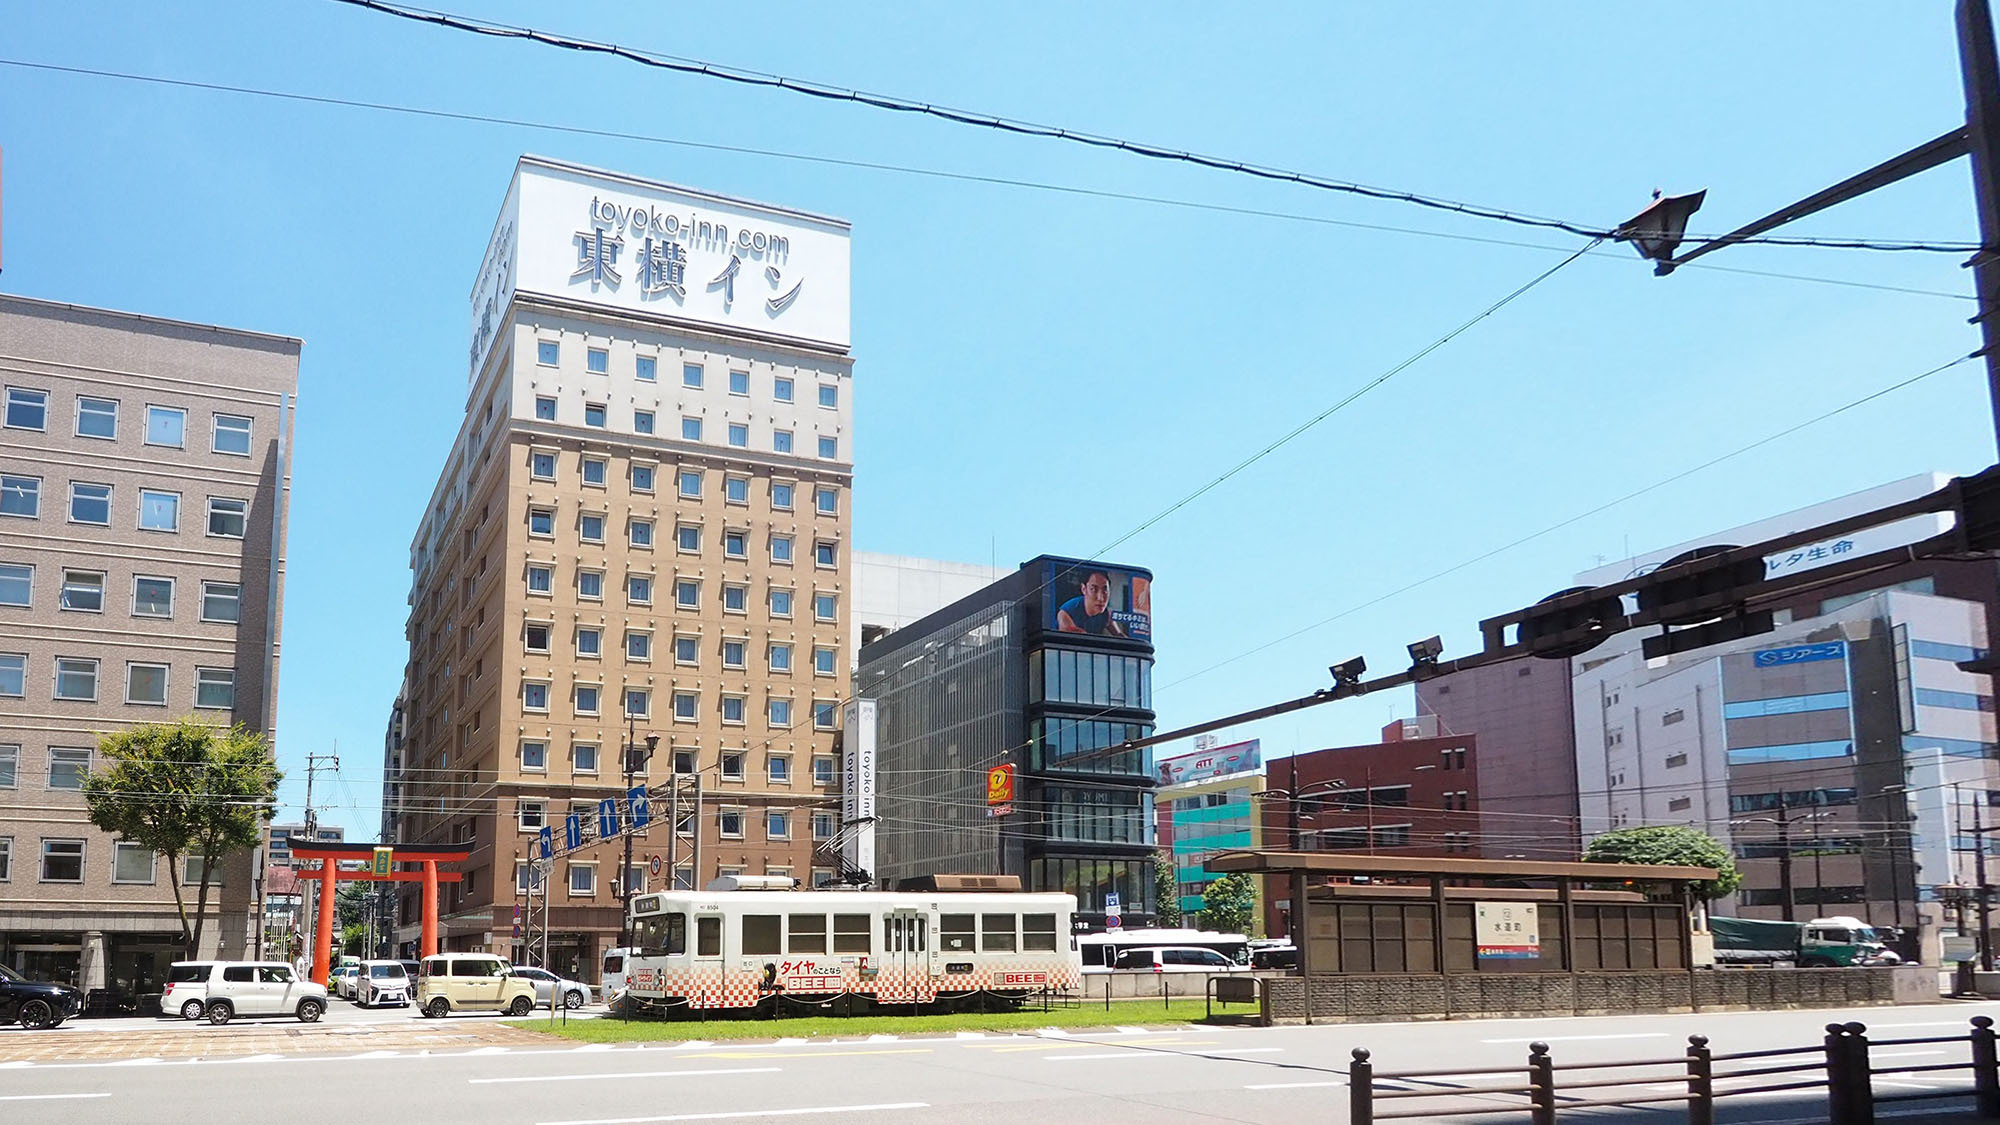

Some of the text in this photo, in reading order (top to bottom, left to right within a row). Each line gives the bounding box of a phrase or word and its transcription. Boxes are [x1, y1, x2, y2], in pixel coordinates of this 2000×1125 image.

[591, 195, 790, 256] toyoko-inn.com
[568, 226, 805, 312] 東横イン
[864, 750, 872, 793] toyoko
[780, 960, 842, 975] タイヤのことなら
[1006, 975, 1032, 983] BEE
[789, 977, 824, 989] BEE
